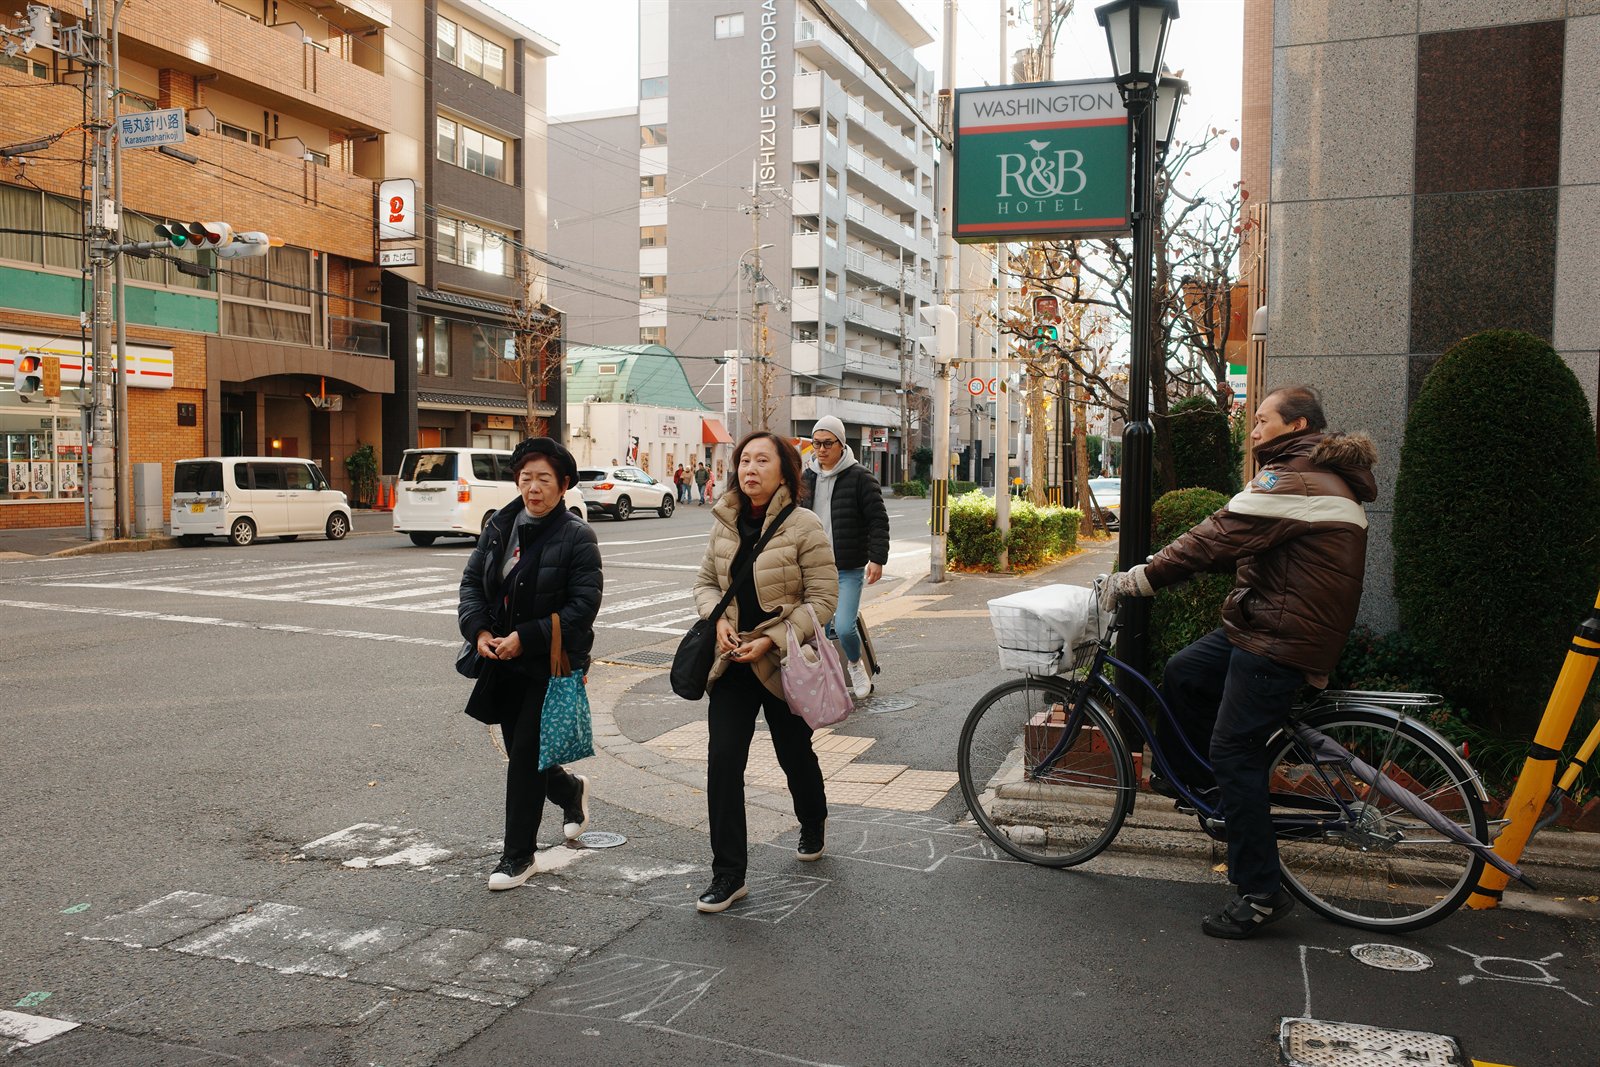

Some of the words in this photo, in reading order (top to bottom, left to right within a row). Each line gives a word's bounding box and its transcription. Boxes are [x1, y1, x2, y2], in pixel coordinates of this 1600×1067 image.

[760, 0, 776, 100] CORPORA
[973, 92, 1114, 118] WASHINGTON
[124, 131, 179, 145] Karasumaharikoji
[760, 105, 776, 184] ISHIZUE
[995, 149, 1087, 199] R&B
[997, 199, 1083, 215] HOTEL
[971, 382, 982, 391] 50
[662, 425, 678, 435] チャコ
